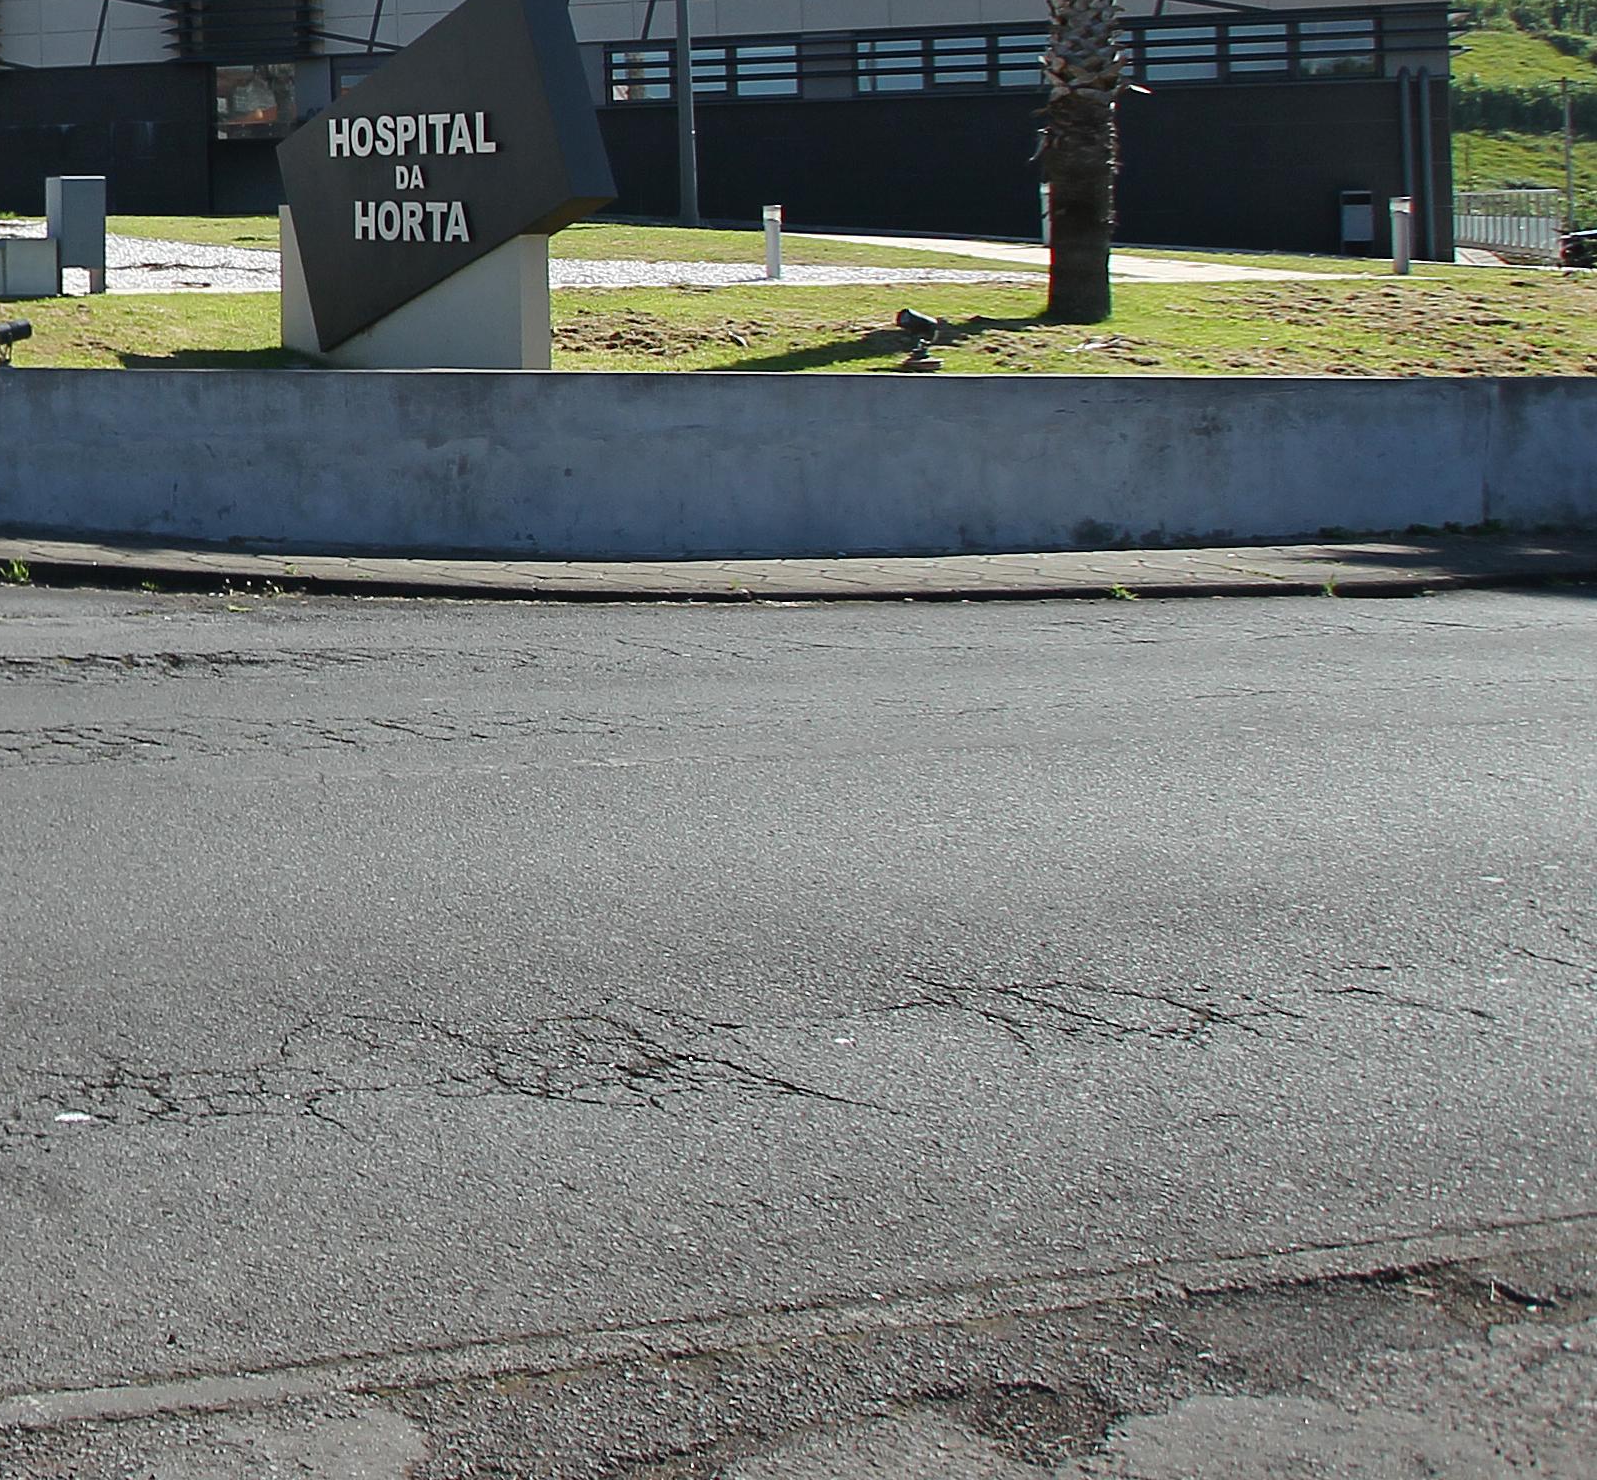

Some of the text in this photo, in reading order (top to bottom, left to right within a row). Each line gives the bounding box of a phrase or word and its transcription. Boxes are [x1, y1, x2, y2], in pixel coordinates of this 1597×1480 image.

[328, 112, 497, 158] HOSPITAL
[395, 165, 425, 190] DA
[354, 200, 470, 243] HORTA
